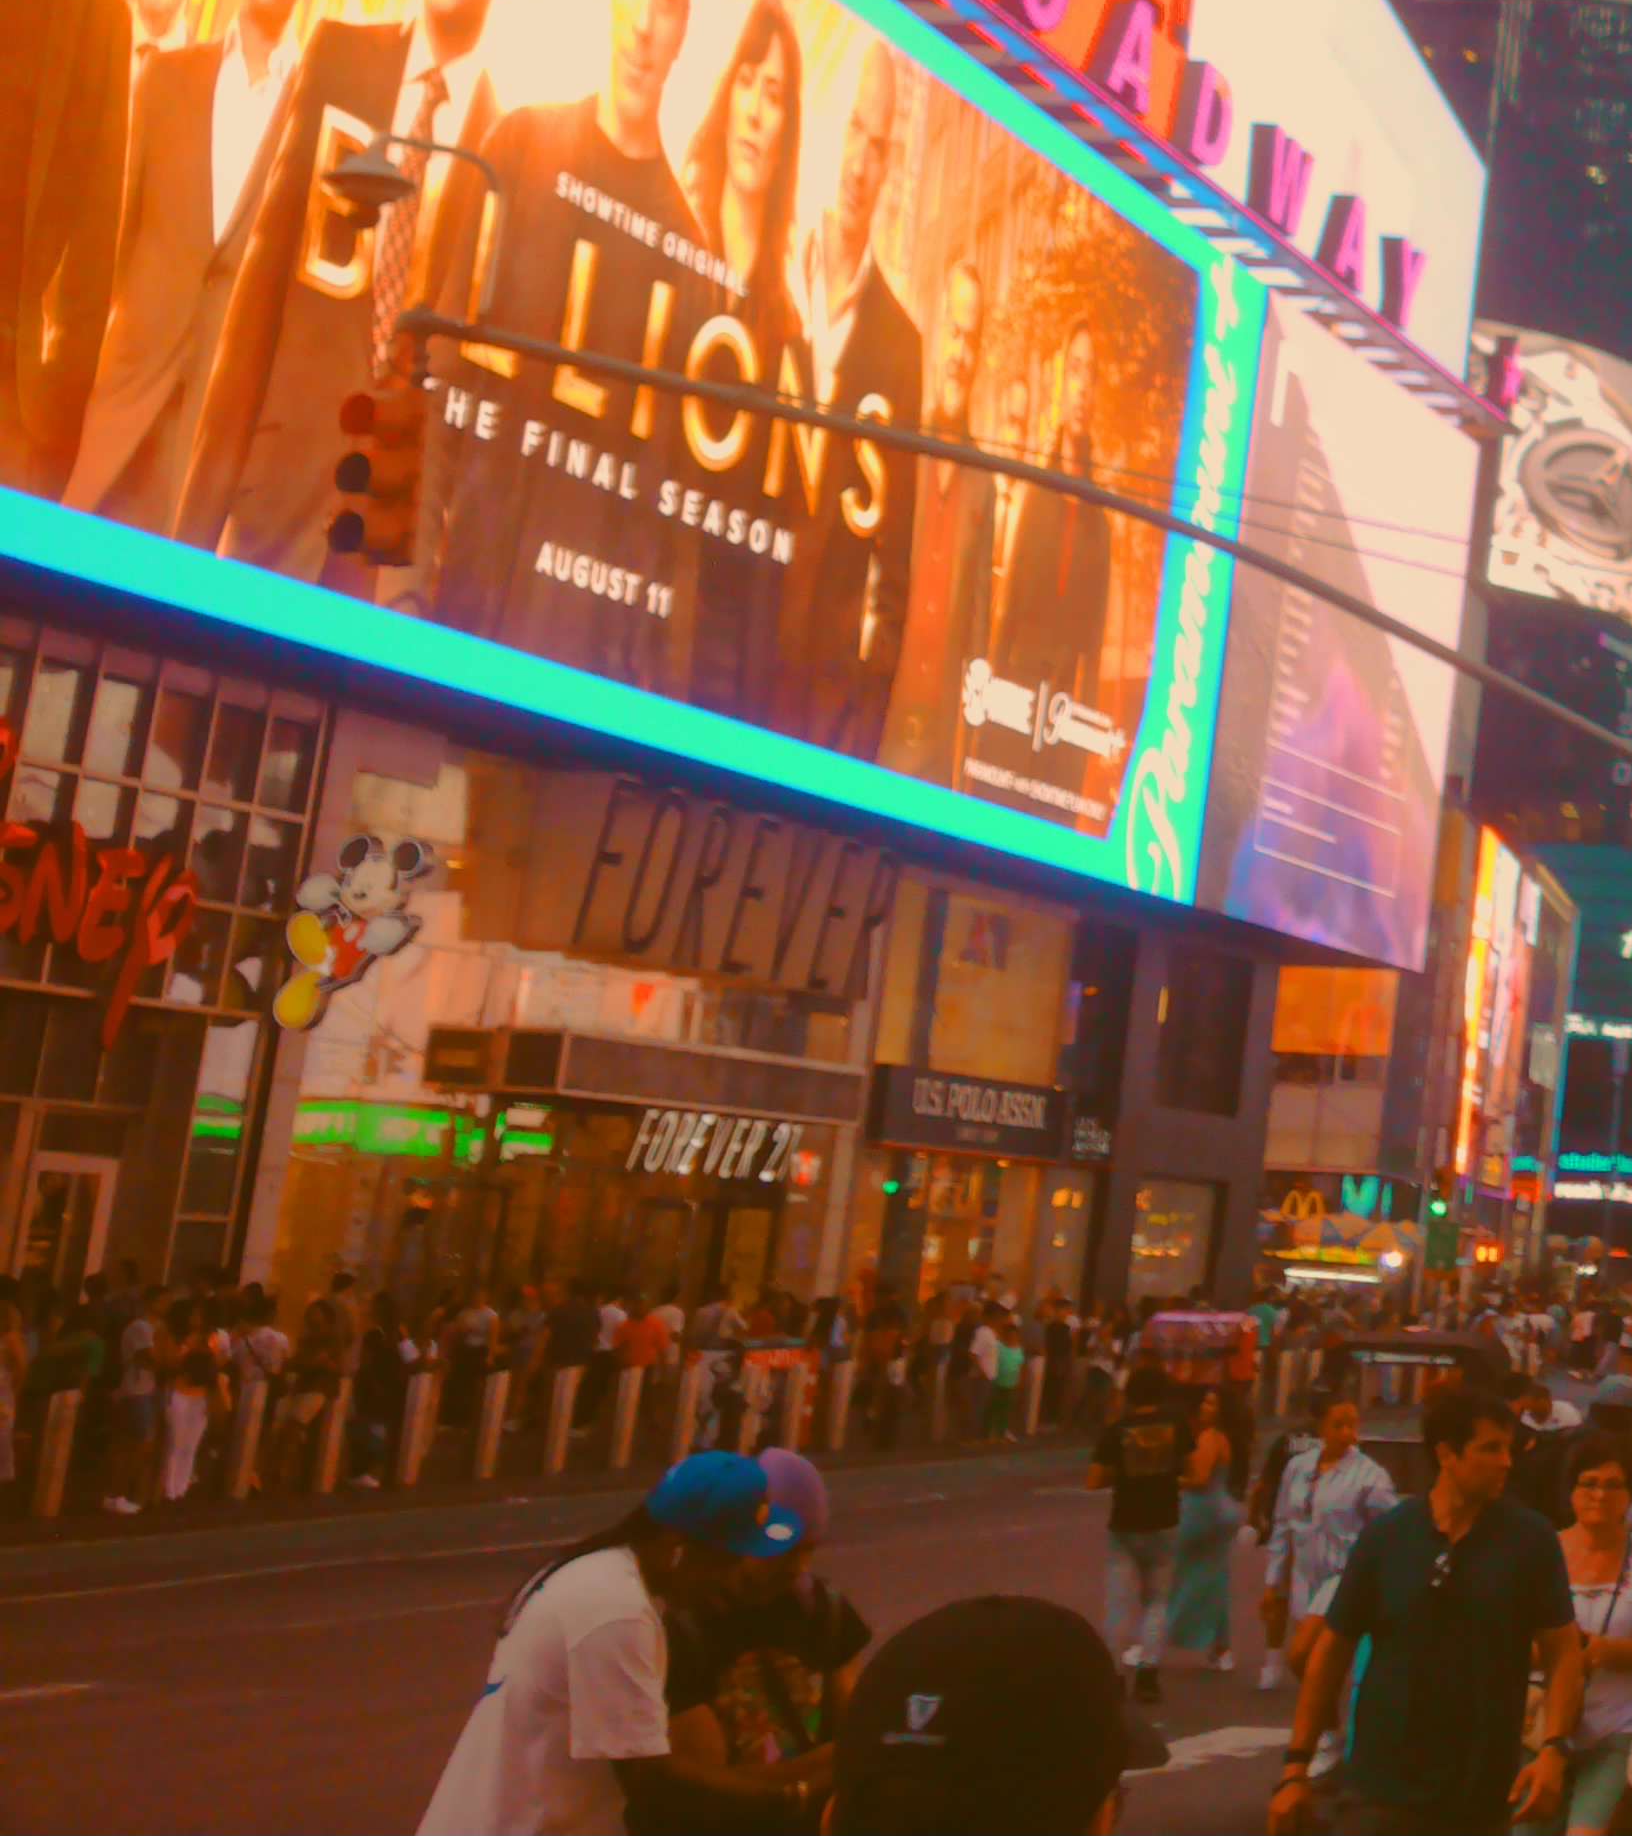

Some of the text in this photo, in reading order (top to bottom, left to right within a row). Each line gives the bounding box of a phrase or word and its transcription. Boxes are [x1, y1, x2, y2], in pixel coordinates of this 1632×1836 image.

[556, 170, 752, 298] SHOWTIME ORIGINAL
[298, 105, 895, 539] BLLIONS
[521, 419, 638, 501] FINAL
[659, 478, 794, 565] SEASON
[536, 541, 672, 619] AUGUST 11
[571, 771, 899, 993] FOREVER
[625, 1108, 769, 1180] FOREVER
